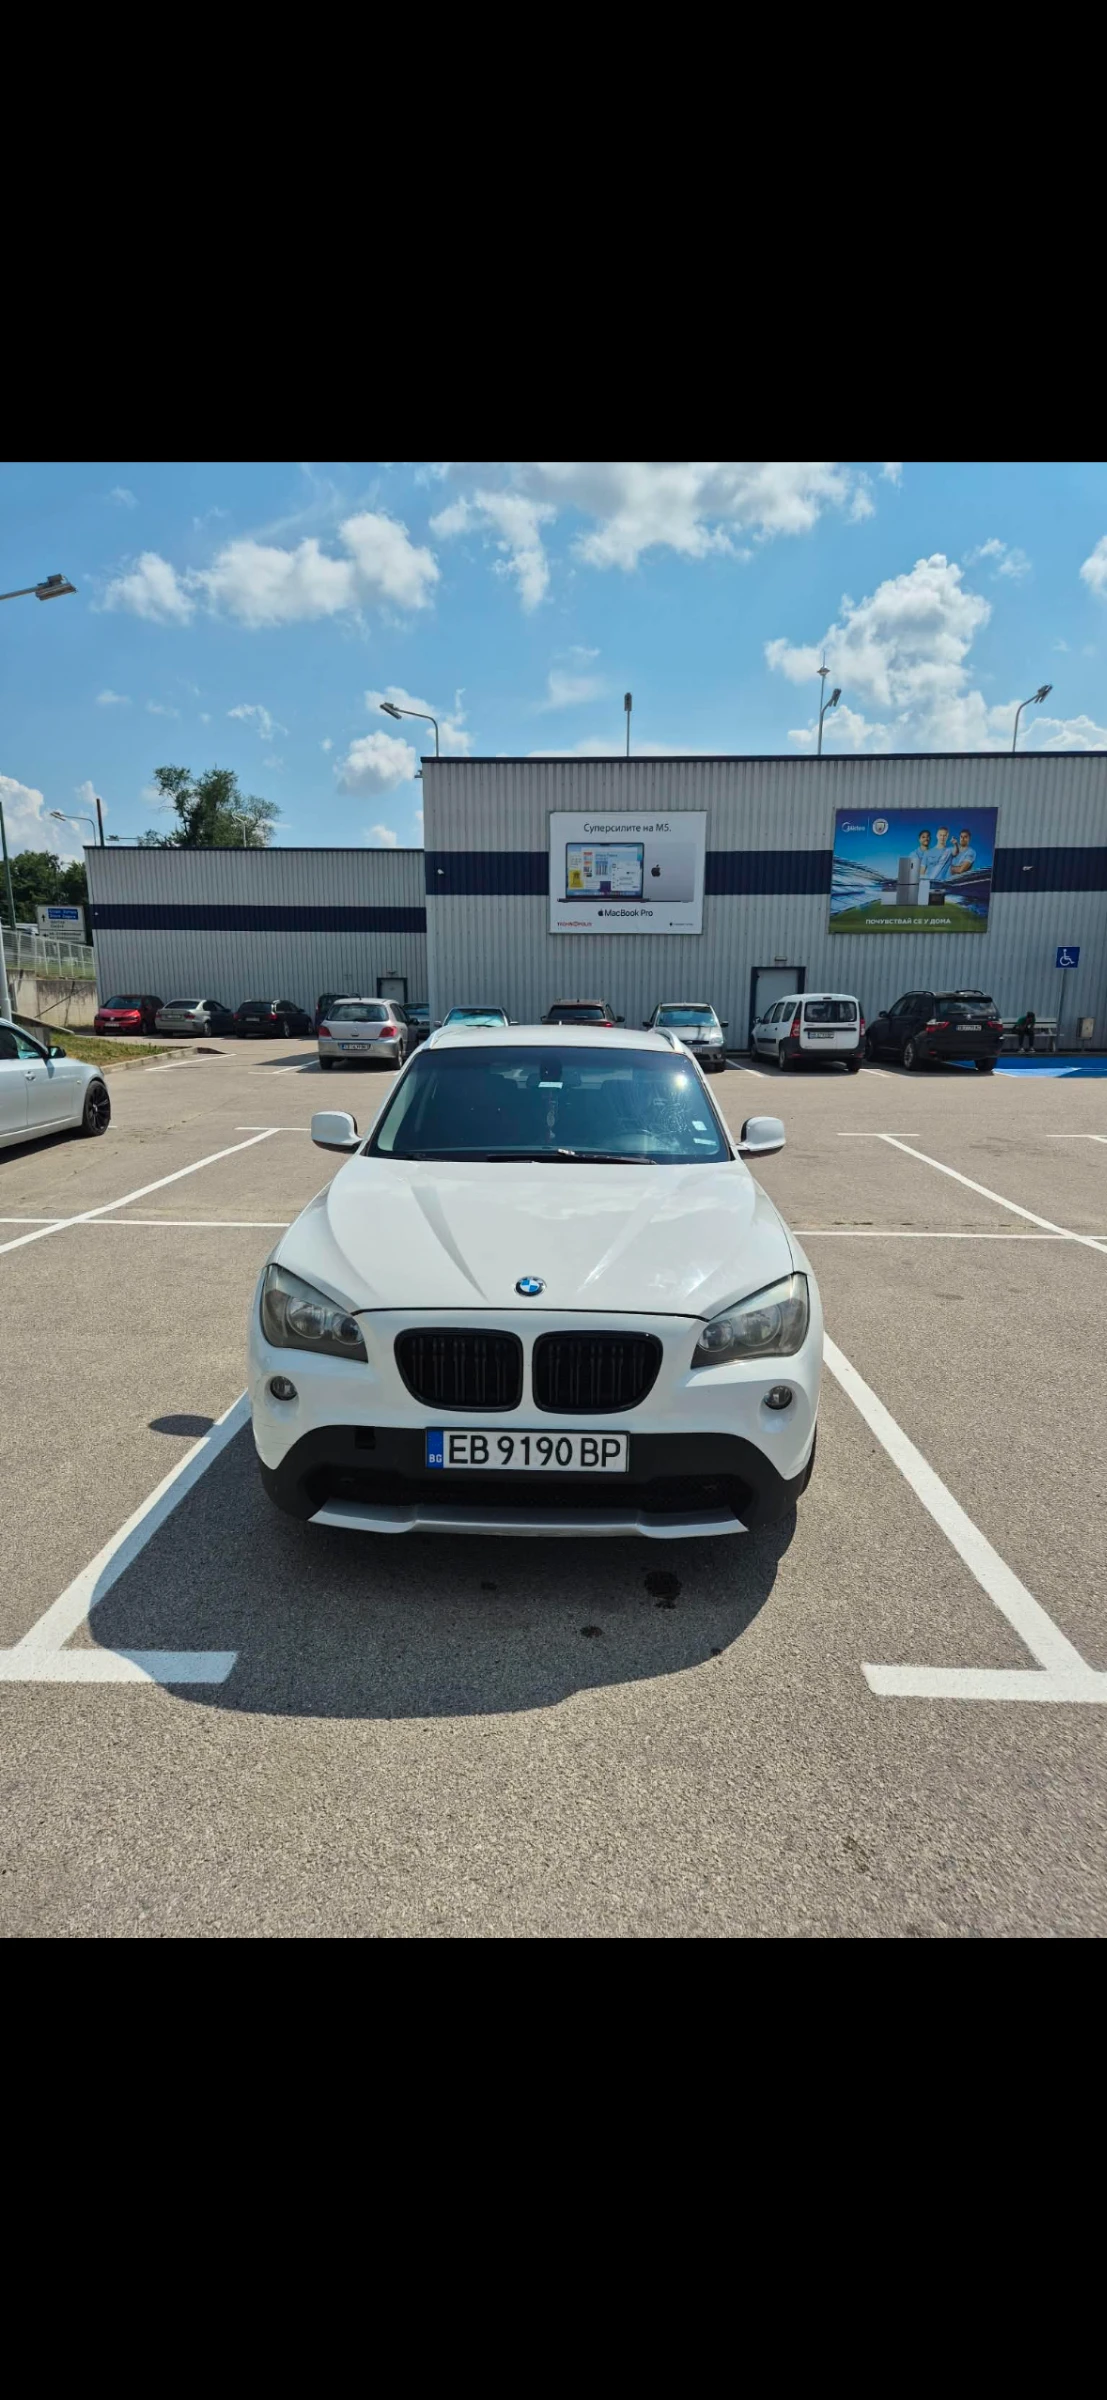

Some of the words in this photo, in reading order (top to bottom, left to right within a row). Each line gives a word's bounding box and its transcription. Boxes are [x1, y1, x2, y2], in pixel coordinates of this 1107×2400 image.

[583, 823, 641, 833] Суперсилите
[605, 909, 639, 917] MacBook
[640, 909, 653, 917] Pro
[865, 917, 912, 925] ПОЧУВСТВАЙ
[930, 918, 951, 926] ДОМА
[449, 1435, 489, 1464] EB
[497, 1436, 573, 1466] 9190
[580, 1438, 621, 1467] BP
[429, 1454, 442, 1463] BG
